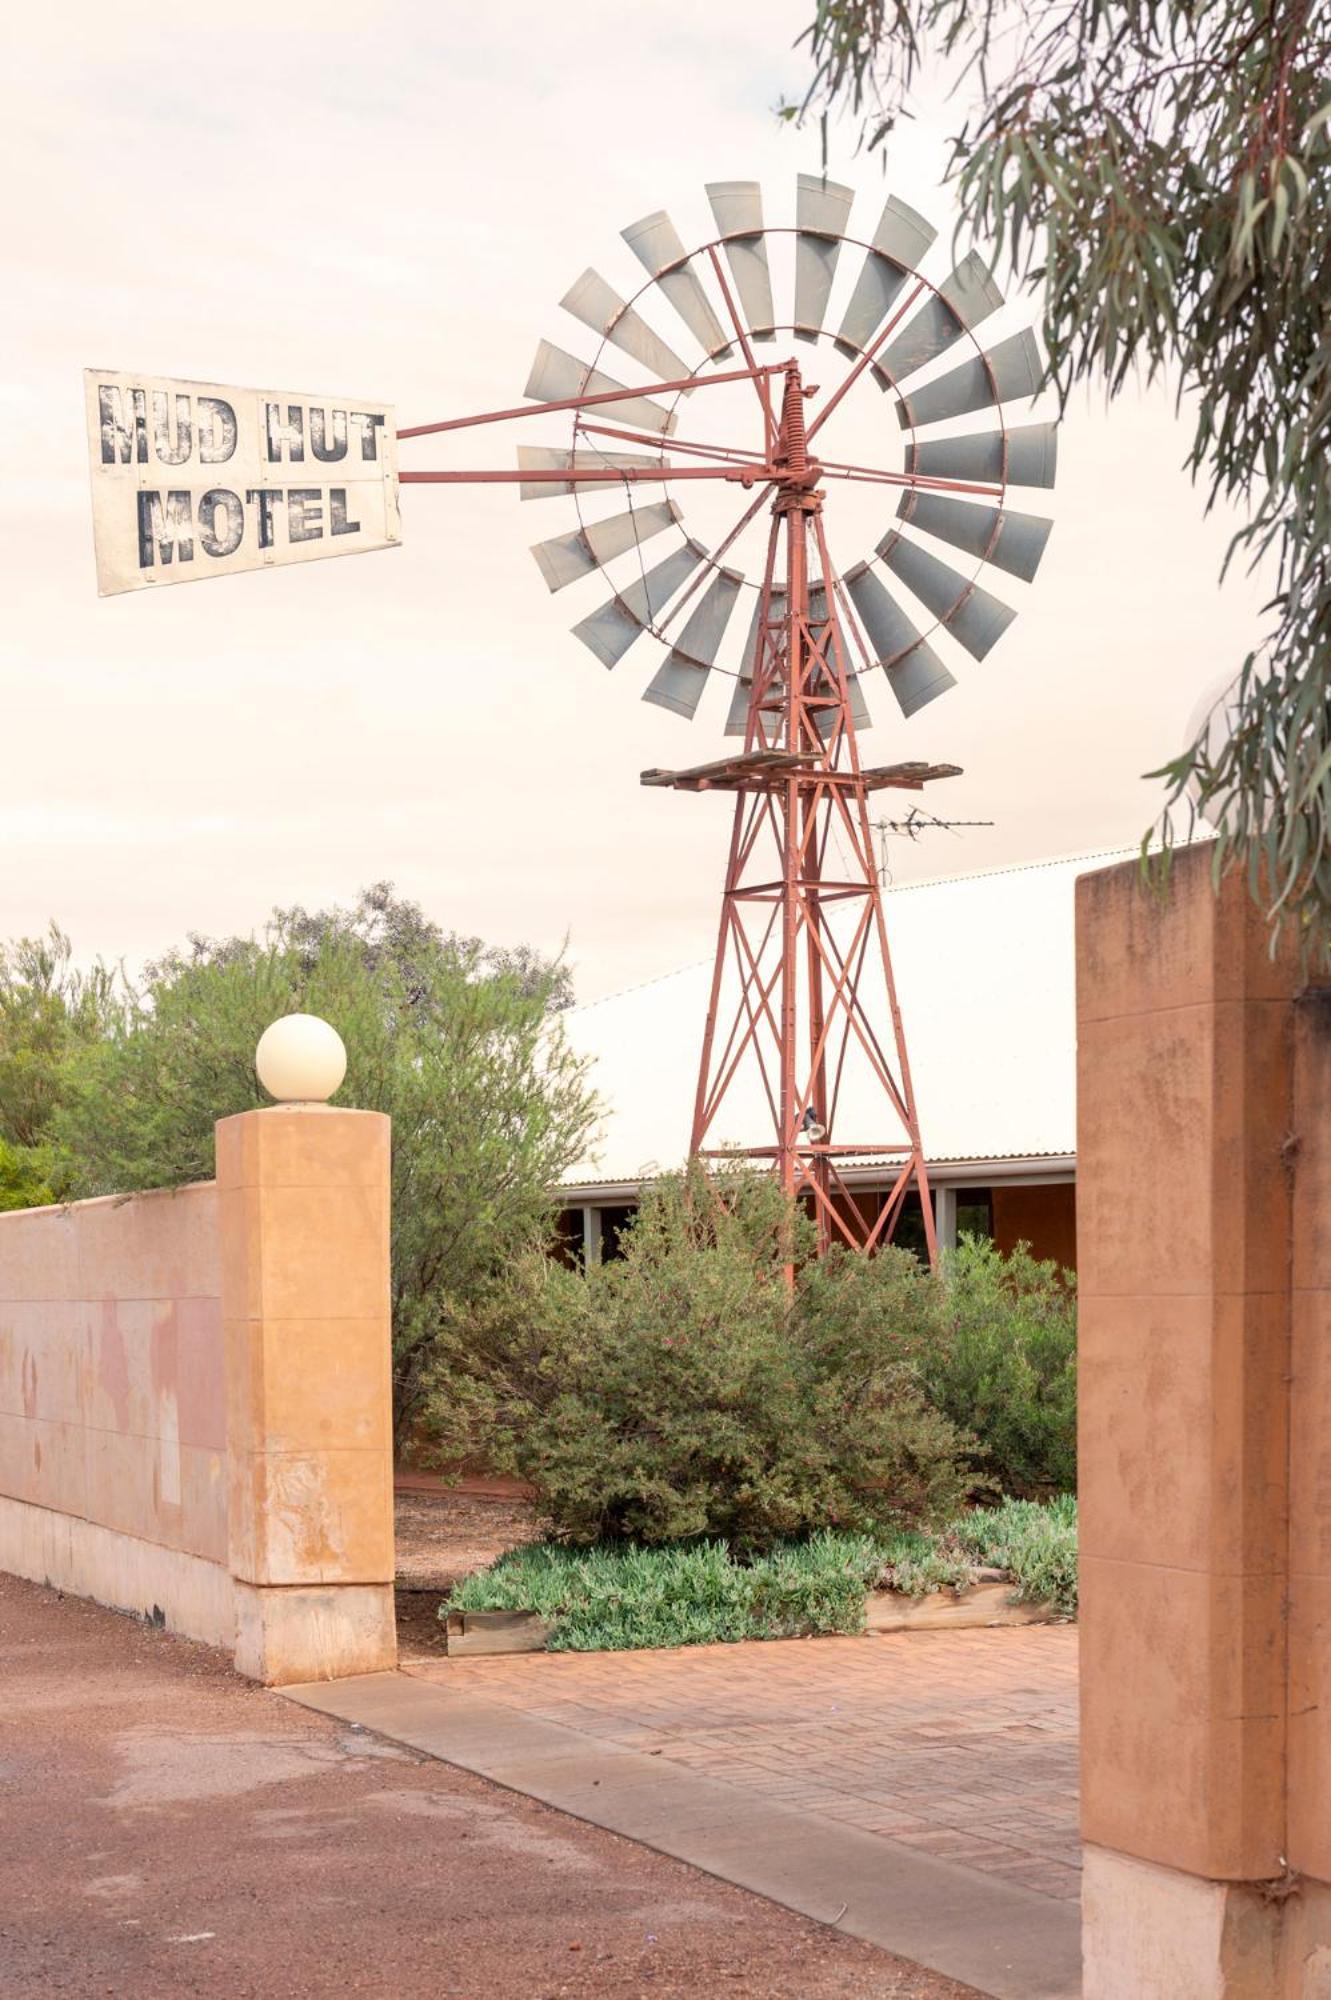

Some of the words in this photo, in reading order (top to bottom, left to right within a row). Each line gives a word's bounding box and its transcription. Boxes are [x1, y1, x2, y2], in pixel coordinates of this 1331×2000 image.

[98, 384, 238, 466] MUD
[265, 402, 386, 463] HUT
[136, 488, 361, 569] MOTEL
